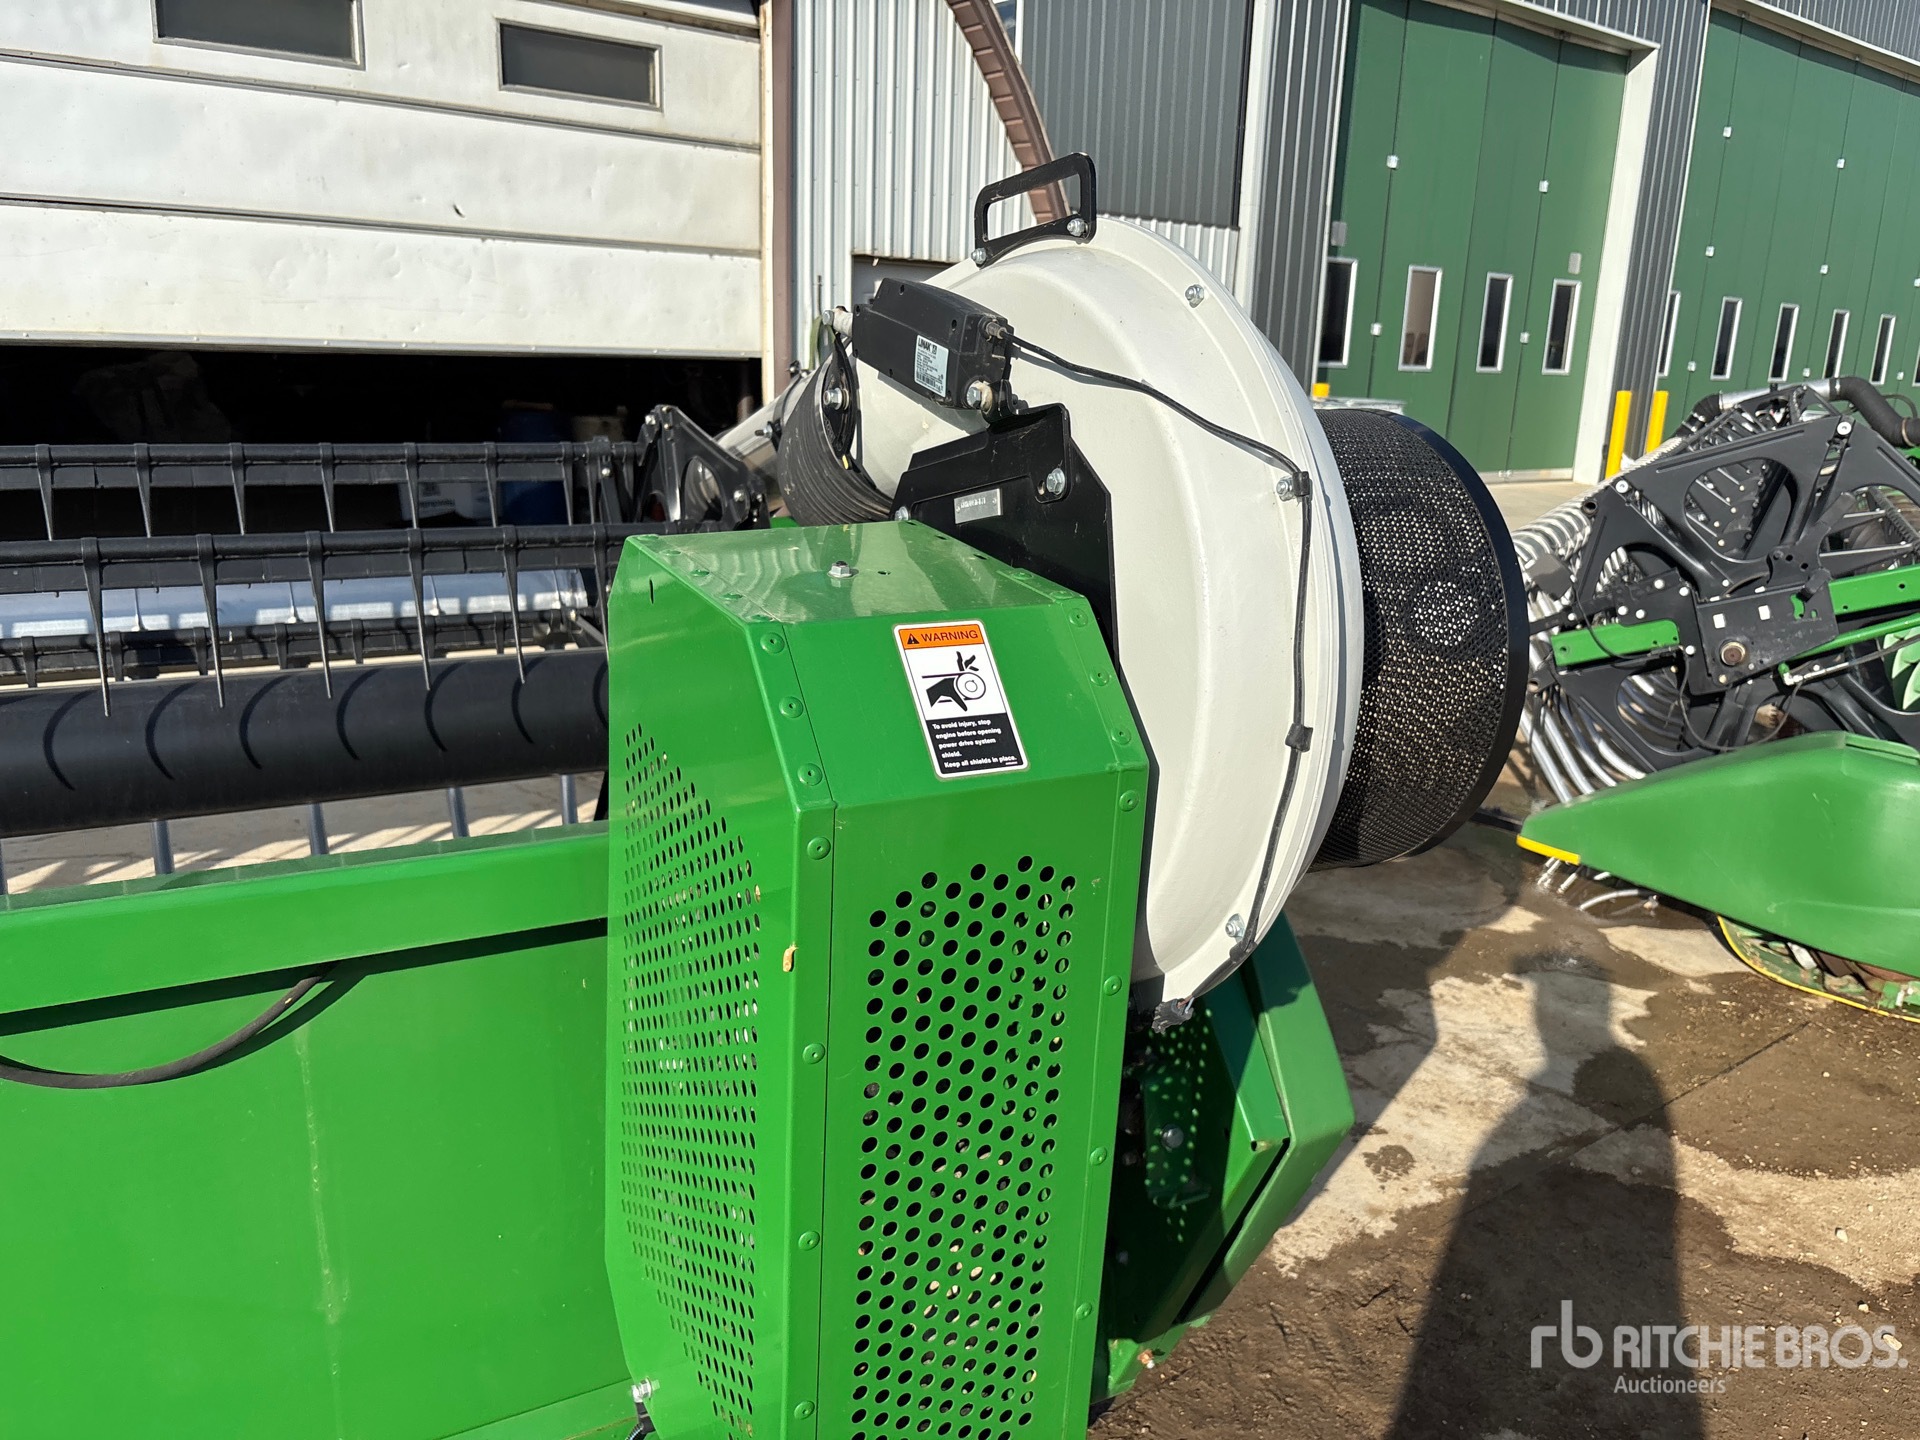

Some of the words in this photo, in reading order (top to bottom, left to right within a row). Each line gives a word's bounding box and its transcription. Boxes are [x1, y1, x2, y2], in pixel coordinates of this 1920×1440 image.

[921, 630, 978, 642] WARNING
[936, 732, 956, 740] engine
[977, 728, 1001, 736] opening
[938, 742, 957, 750] power
[975, 738, 996, 746] system
[970, 757, 991, 765] shields
[999, 755, 1017, 763] place.
